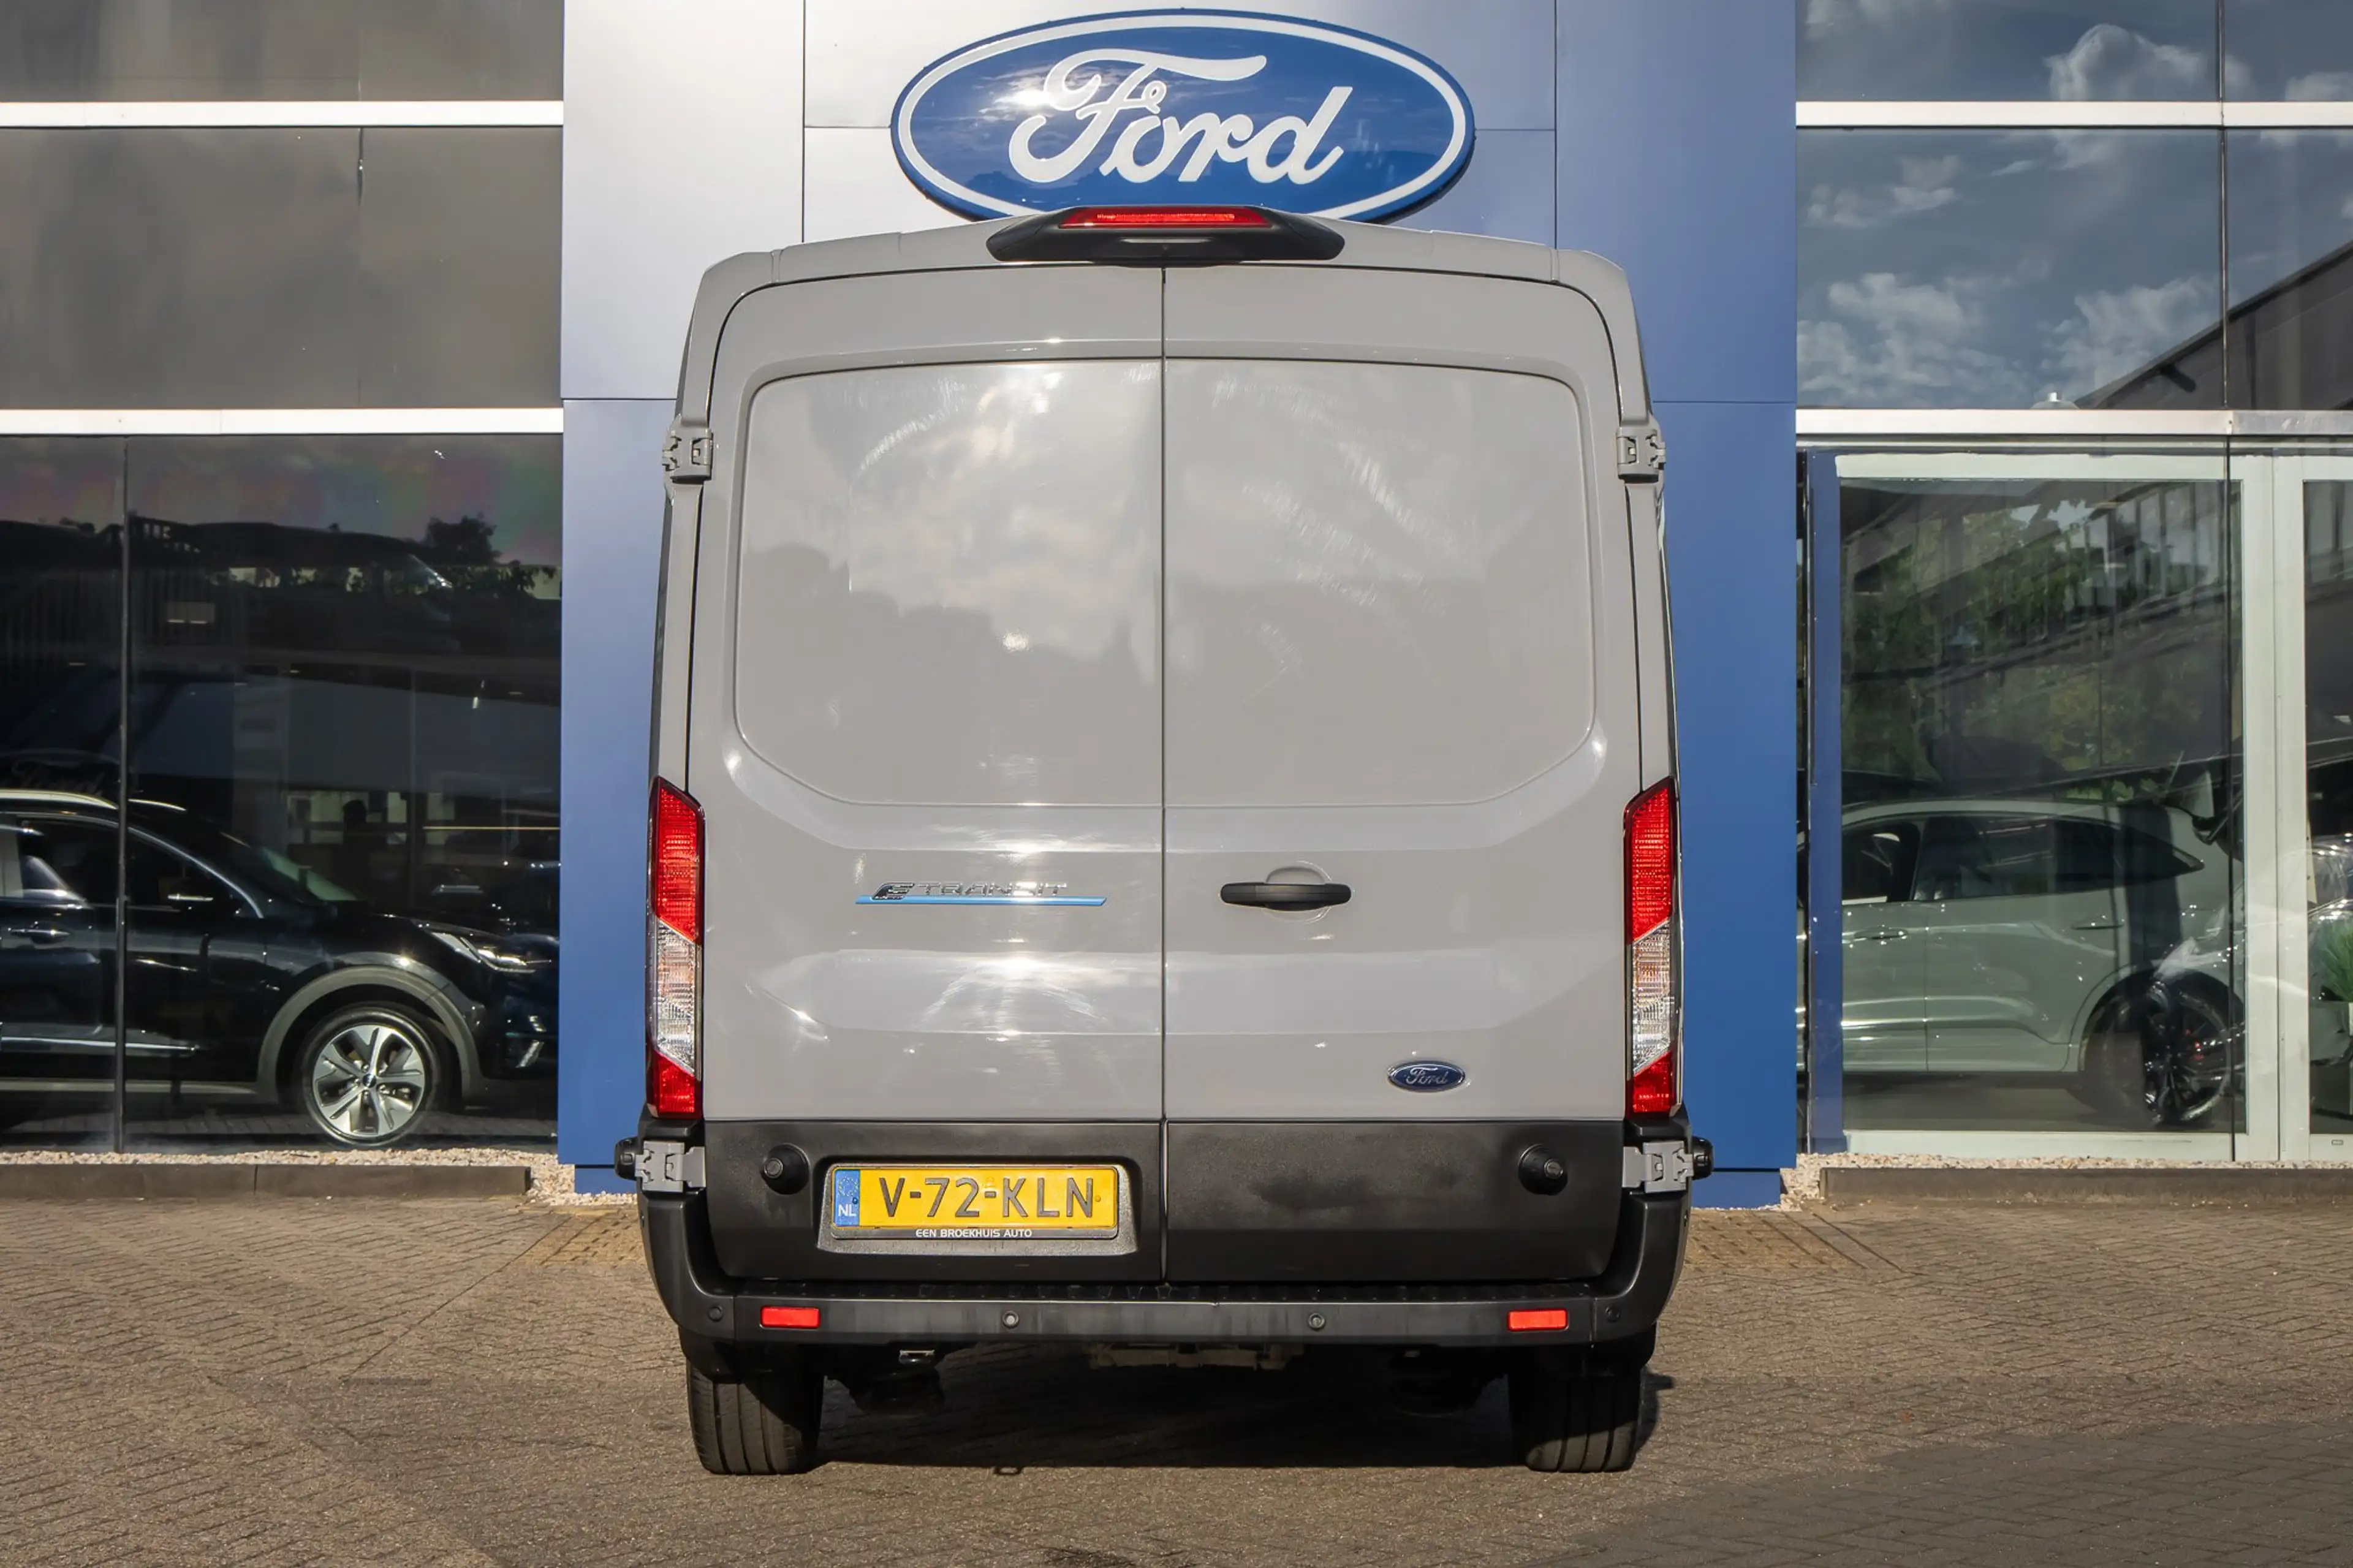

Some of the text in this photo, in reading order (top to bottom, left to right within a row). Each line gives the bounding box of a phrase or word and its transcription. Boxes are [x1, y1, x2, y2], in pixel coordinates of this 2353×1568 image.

[1009, 48, 1353, 185] Ford
[1405, 1067, 1449, 1085] Ford
[879, 1177, 1093, 1218] V-72-KLN
[838, 1203, 857, 1217] NL
[915, 1229, 1033, 1238] EEN BROEKHUIS AUTO
